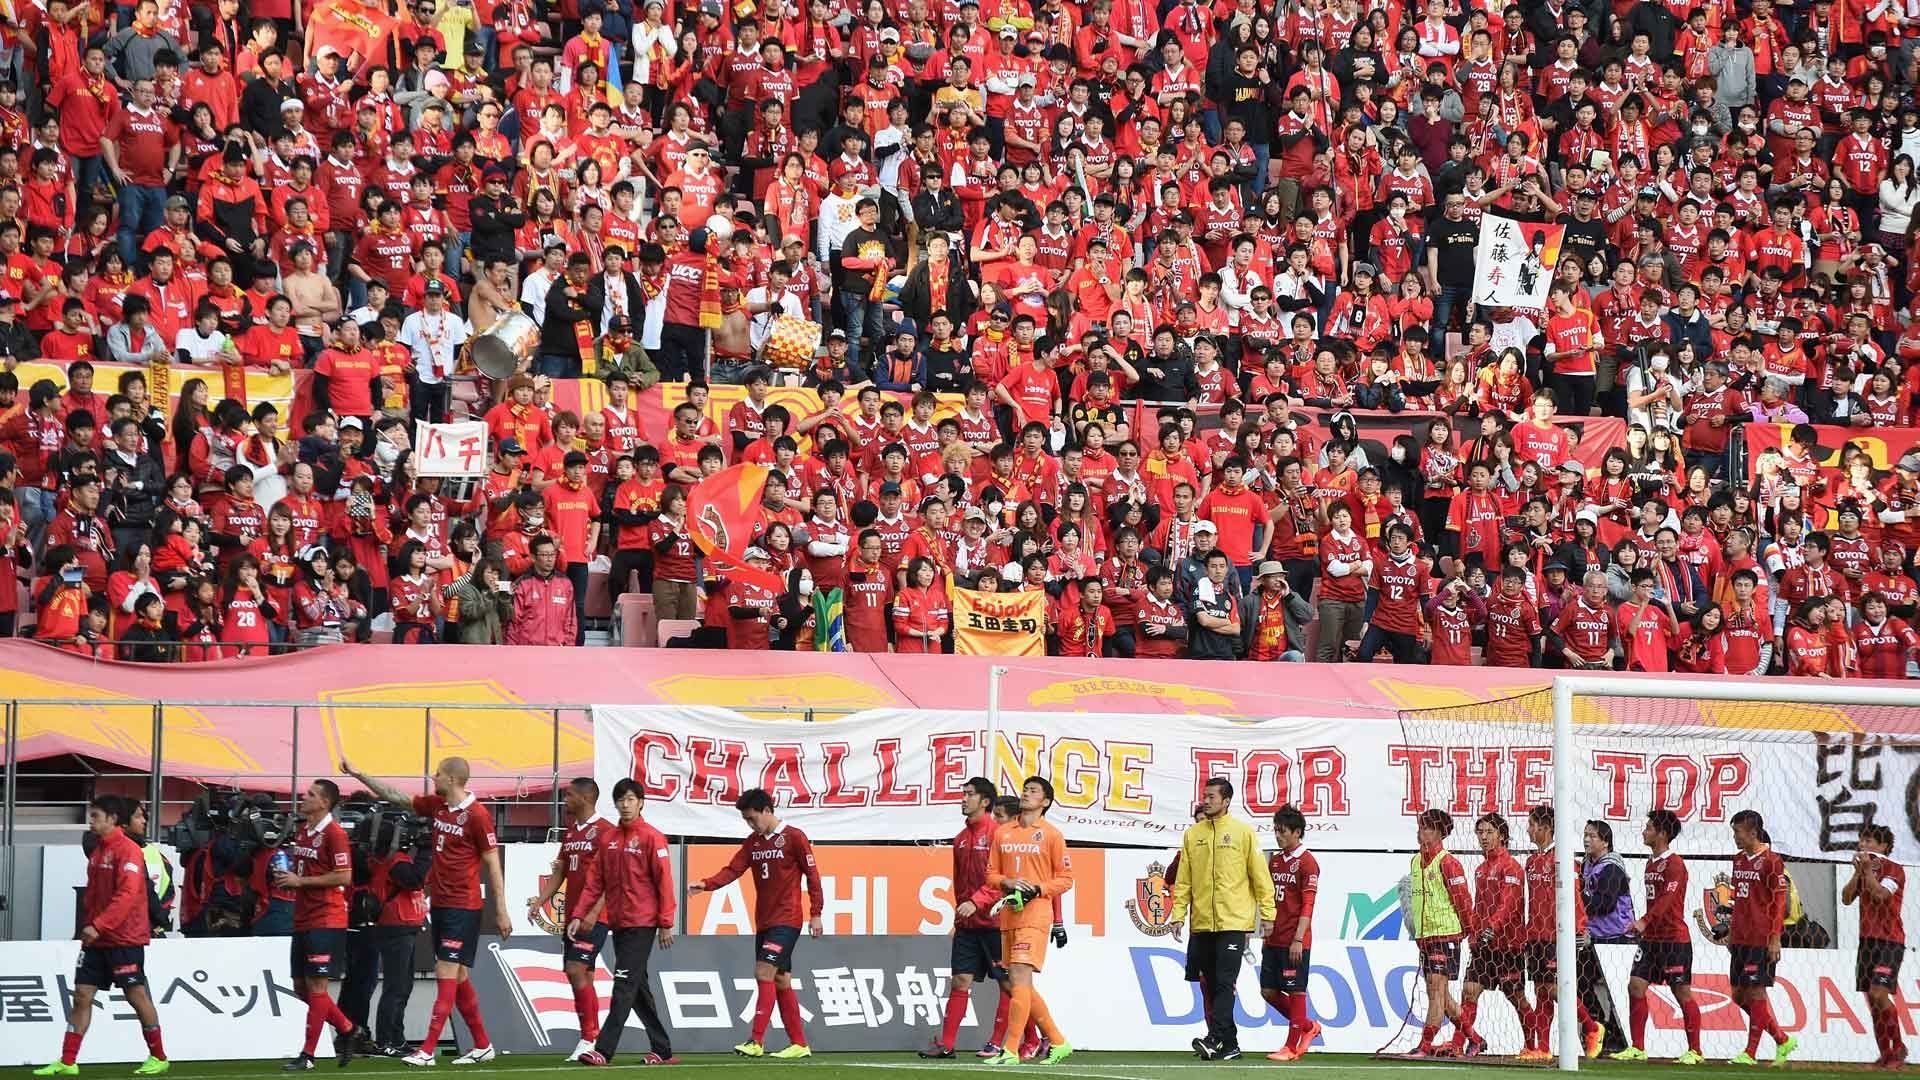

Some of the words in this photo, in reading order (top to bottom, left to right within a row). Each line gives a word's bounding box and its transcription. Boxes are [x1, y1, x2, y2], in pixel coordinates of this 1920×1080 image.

[1332, 32, 1351, 41] TOYO
[763, 81, 792, 90] TOYOTA
[1477, 81, 1490, 91] 29
[1825, 93, 1849, 101] TOYOTA
[867, 100, 889, 108] TOYO
[527, 110, 542, 119] TOY
[131, 122, 162, 132] TOYOTA
[666, 152, 687, 160] TOYO
[1086, 156, 1108, 164] OYOTA
[1860, 160, 1870, 171] 12
[854, 172, 868, 180] OTA
[1190, 171, 1199, 182] 15
[683, 184, 716, 193] TOYOTA
[697, 192, 707, 206] 12
[1462, 207, 1481, 215] OYO
[1208, 221, 1239, 231] TOYOTA
[1311, 228, 1335, 238] YOTA
[1040, 245, 1067, 256] TOYOTA
[1397, 247, 1402, 258] 7
[1763, 247, 1792, 256] TOYOTA
[1484, 221, 1512, 304] 佐藤寿人
[1680, 253, 1687, 264] 7
[670, 265, 701, 278] UCC
[784, 282, 808, 293] OYOTA
[1355, 311, 1365, 323] 8
[1512, 305, 1540, 318] OYOTA
[1559, 327, 1586, 339] TOYOTA
[1768, 363, 1788, 373] OYOT
[1873, 412, 1895, 422] YOTA
[423, 428, 480, 472] ハチ
[591, 465, 608, 473] OTA
[782, 488, 800, 499] OTA
[1319, 489, 1347, 497] OYOTA
[937, 529, 962, 542] YOTA
[677, 542, 689, 555] 12
[1834, 552, 1869, 562] TOYOTA
[1383, 574, 1415, 587] TOYOTA
[855, 583, 885, 591] TOYOTA
[1391, 586, 1403, 599] 12
[866, 593, 876, 607] 11
[972, 598, 1033, 617] Enjoy!
[238, 612, 255, 626] 28
[1576, 621, 1607, 629] TOYOTA
[1450, 630, 1460, 643] 11
[1589, 632, 1598, 645] 11
[629, 729, 1153, 815] CHALLENGE
[1190, 745, 1350, 817] FOR
[1388, 744, 1552, 818] THE
[1592, 749, 1752, 823] TOP
[1067, 815, 1136, 828] Powered
[1144, 821, 1167, 833] by
[1256, 823, 1338, 832] NOYA
[564, 841, 592, 850] TOYOTA
[1002, 842, 1040, 853] TOYOTA
[752, 850, 784, 859] TOYOTA
[762, 863, 768, 879] 3
[700, 876, 888, 935] AHI
[658, 966, 978, 1028] 日本郵船
[1766, 976, 1920, 1036] DAH
